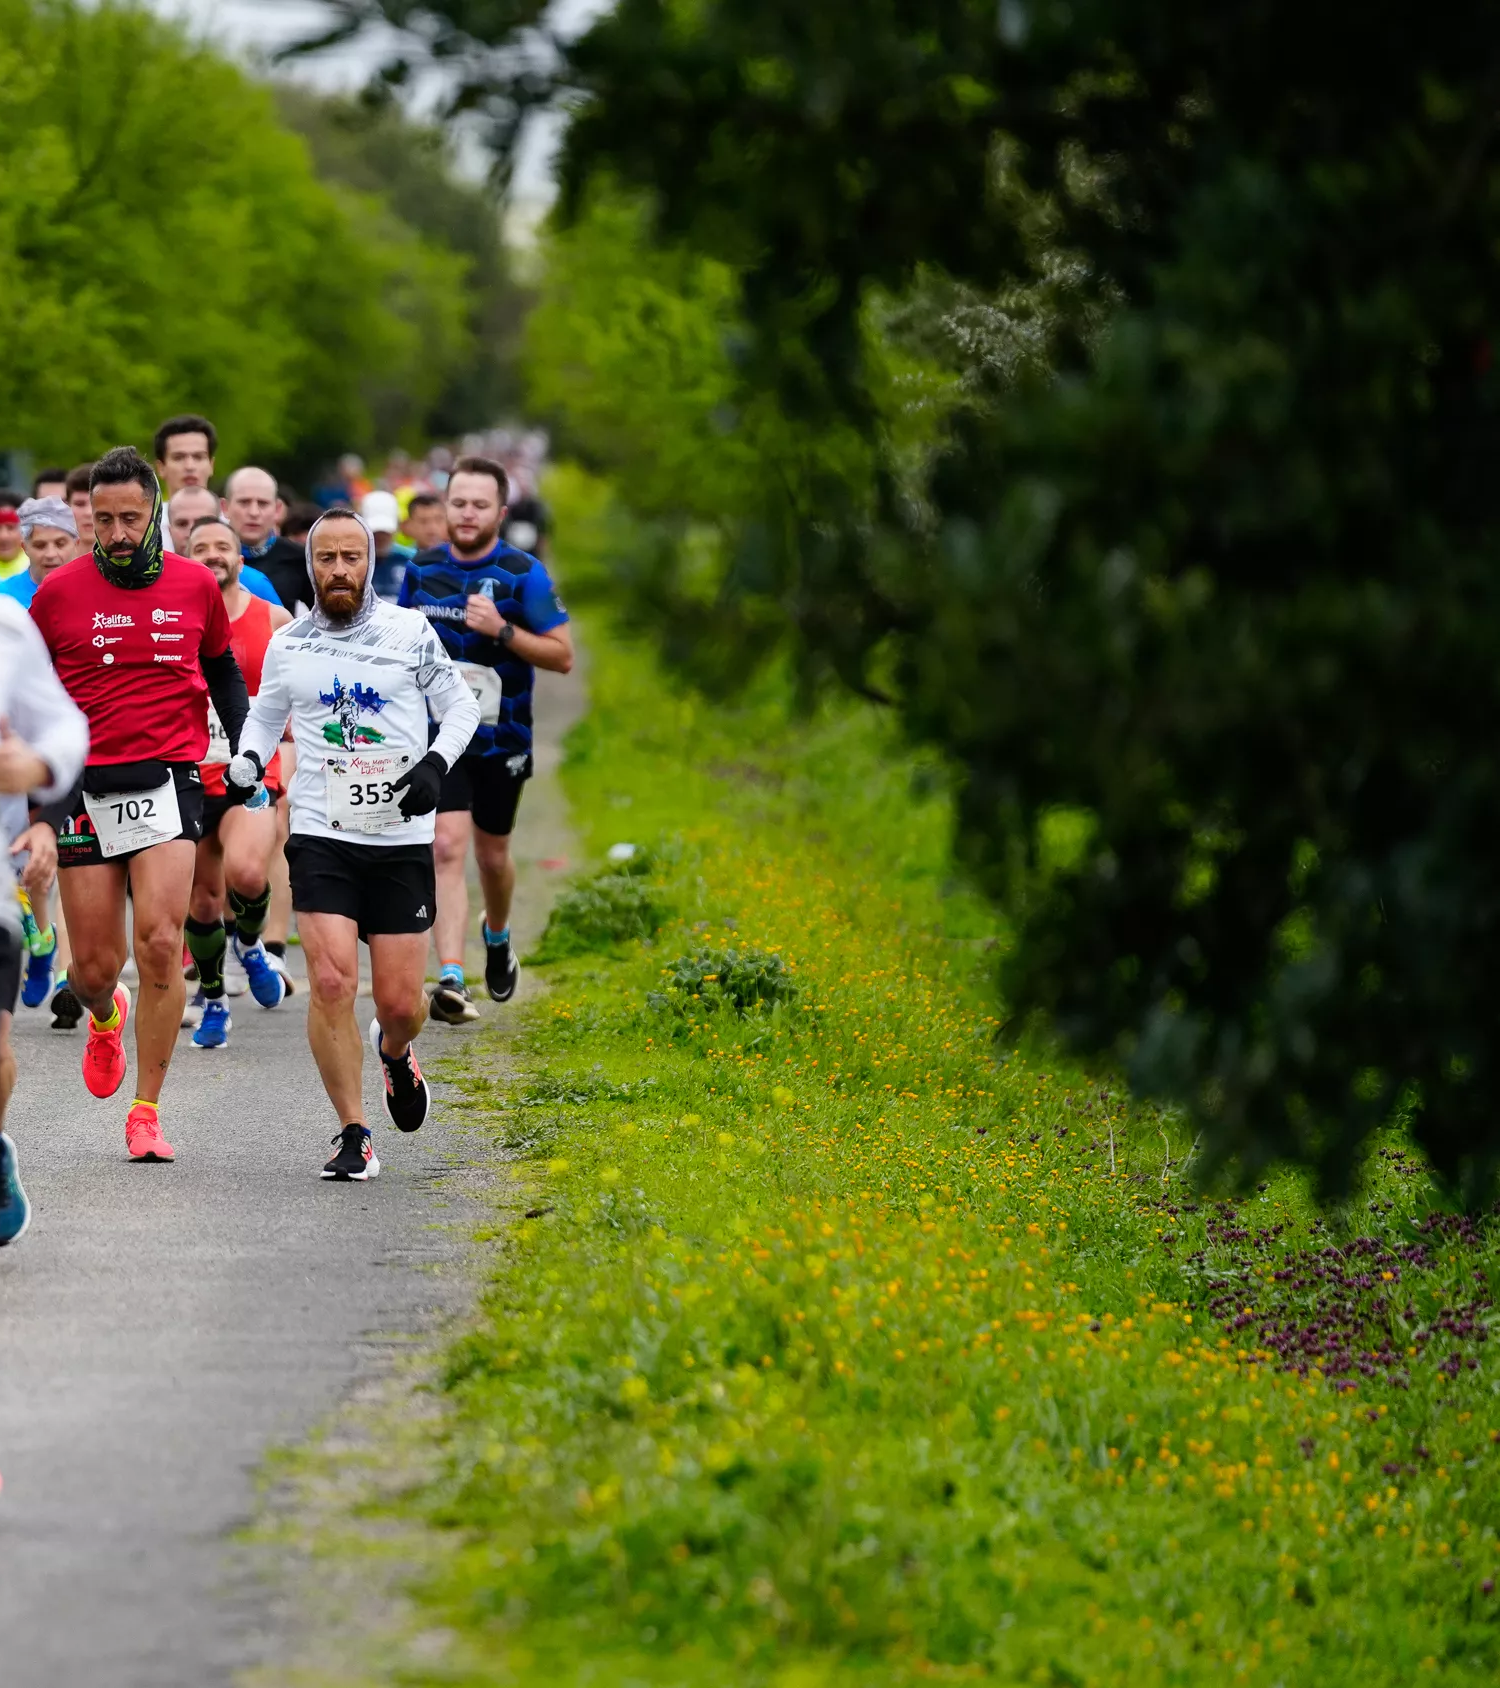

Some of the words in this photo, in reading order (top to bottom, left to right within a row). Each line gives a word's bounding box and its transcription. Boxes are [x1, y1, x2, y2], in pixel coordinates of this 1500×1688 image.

[101, 614, 132, 626] califas
[349, 781, 395, 806] 353
[110, 798, 157, 824] 702
